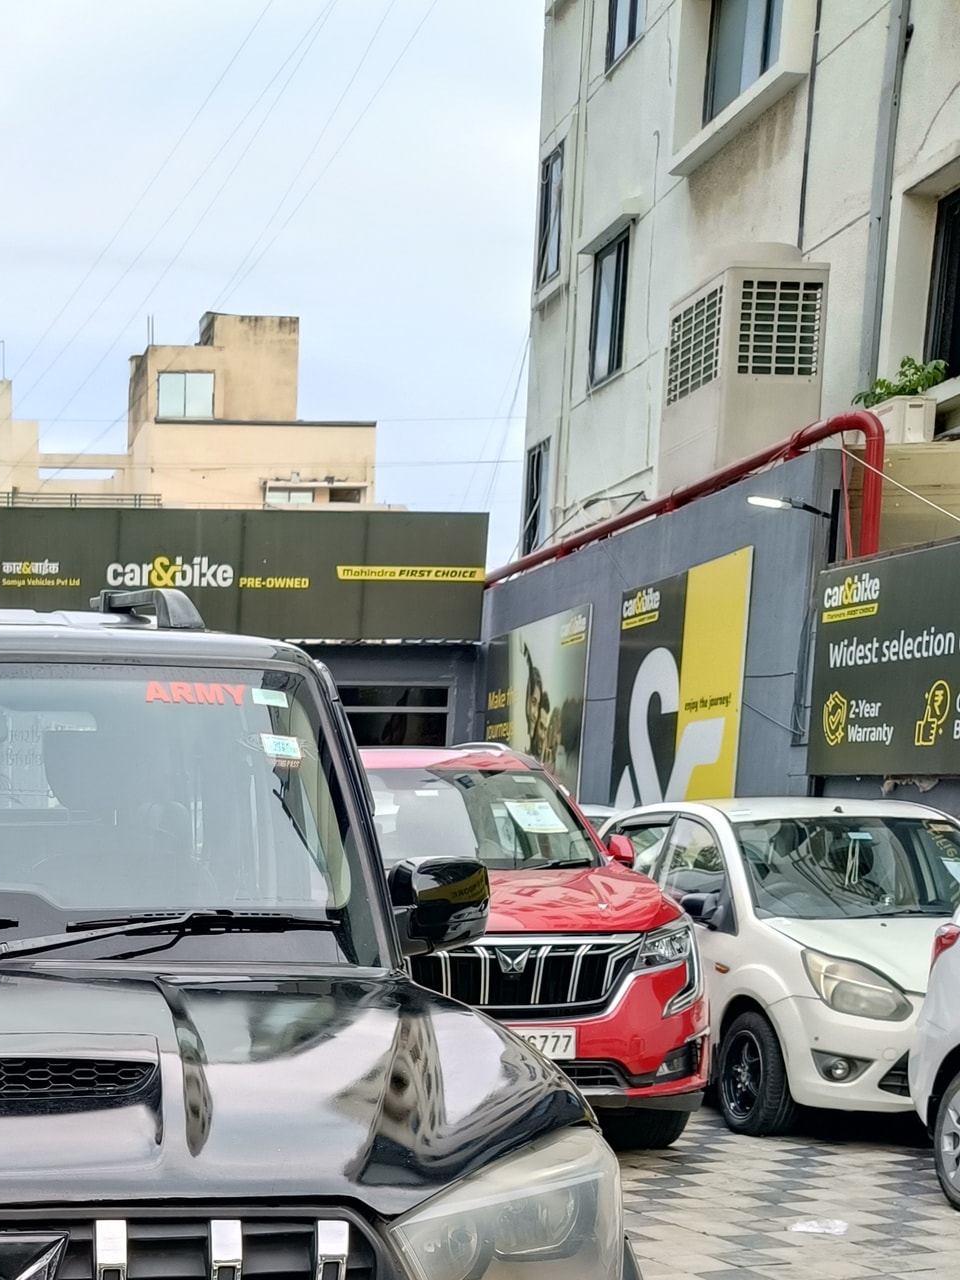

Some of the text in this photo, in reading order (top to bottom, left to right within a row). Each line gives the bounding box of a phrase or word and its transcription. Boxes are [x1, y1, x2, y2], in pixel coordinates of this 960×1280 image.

[27, 578, 55, 586] Vehicles
[56, 578, 68, 586] Pvt
[69, 578, 80, 586] Ltd
[106, 556, 234, 588] car&bike
[239, 577, 310, 588] PRE-OWNED
[342, 568, 477, 578] Mahindra FIRST CHOICE
[823, 572, 881, 609] car&bike
[622, 587, 661, 618] car&bike
[828, 626, 956, 669] Widest selection
[145, 680, 247, 706] ARMY
[849, 699, 882, 718] 2-Year
[847, 723, 895, 745] Warranty
[521, 1033, 573, 1053] 6777
